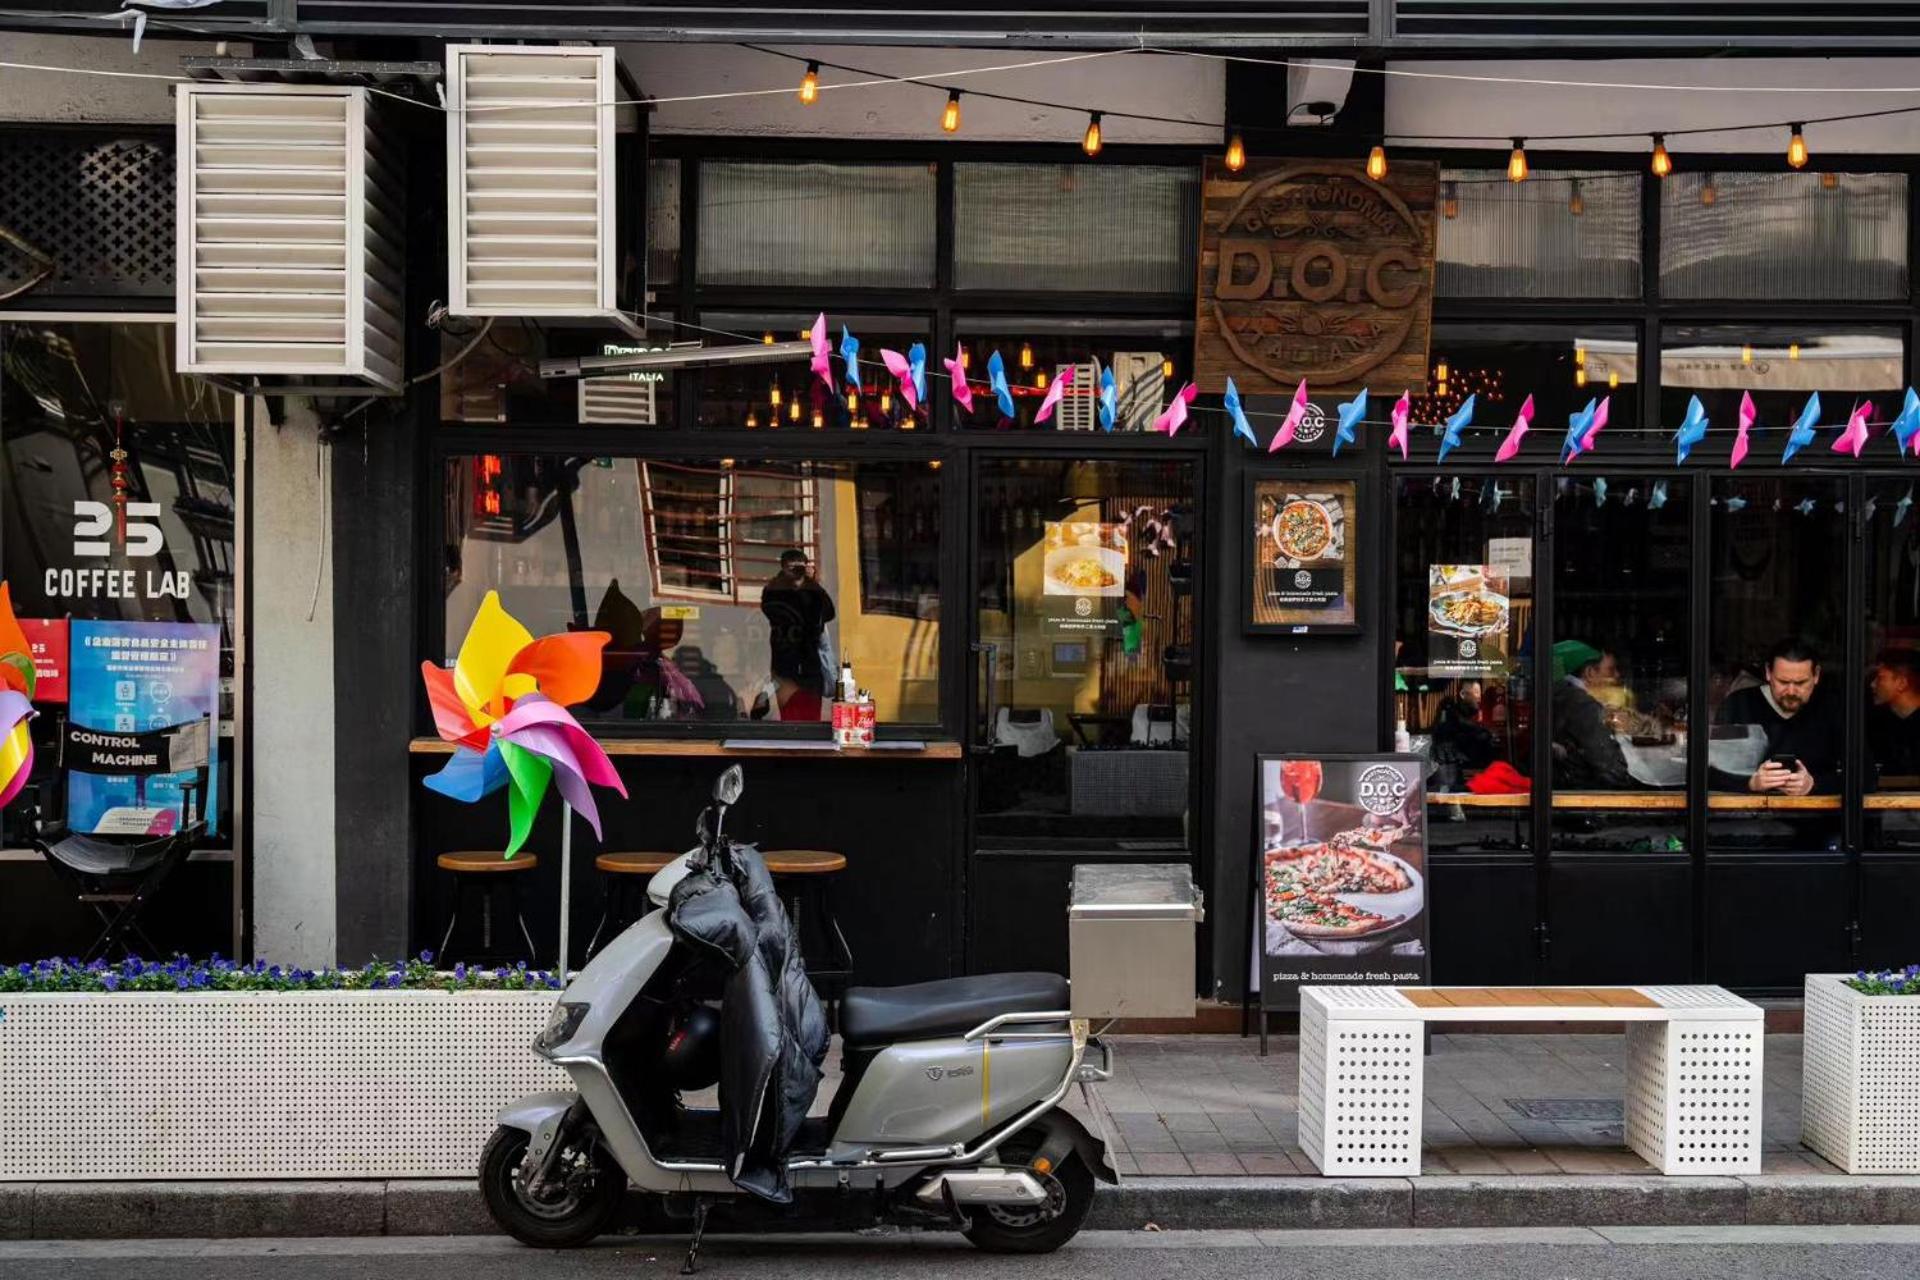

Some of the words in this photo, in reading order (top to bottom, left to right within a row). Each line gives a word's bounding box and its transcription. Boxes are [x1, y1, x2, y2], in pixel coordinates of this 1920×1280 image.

[629, 372, 664, 382] ITALIA
[74, 500, 163, 557] 25
[45, 568, 136, 598] COFFEE
[146, 570, 190, 599] LAB
[32, 643, 46, 653] 25
[71, 731, 140, 748] CONTROL
[92, 752, 158, 766] MACHINE
[1273, 972, 1299, 982] pizza
[1301, 971, 1310, 980] &
[1311, 972, 1364, 980] homemade
[1366, 972, 1391, 980] fresh
[1392, 973, 1420, 981] pasta
